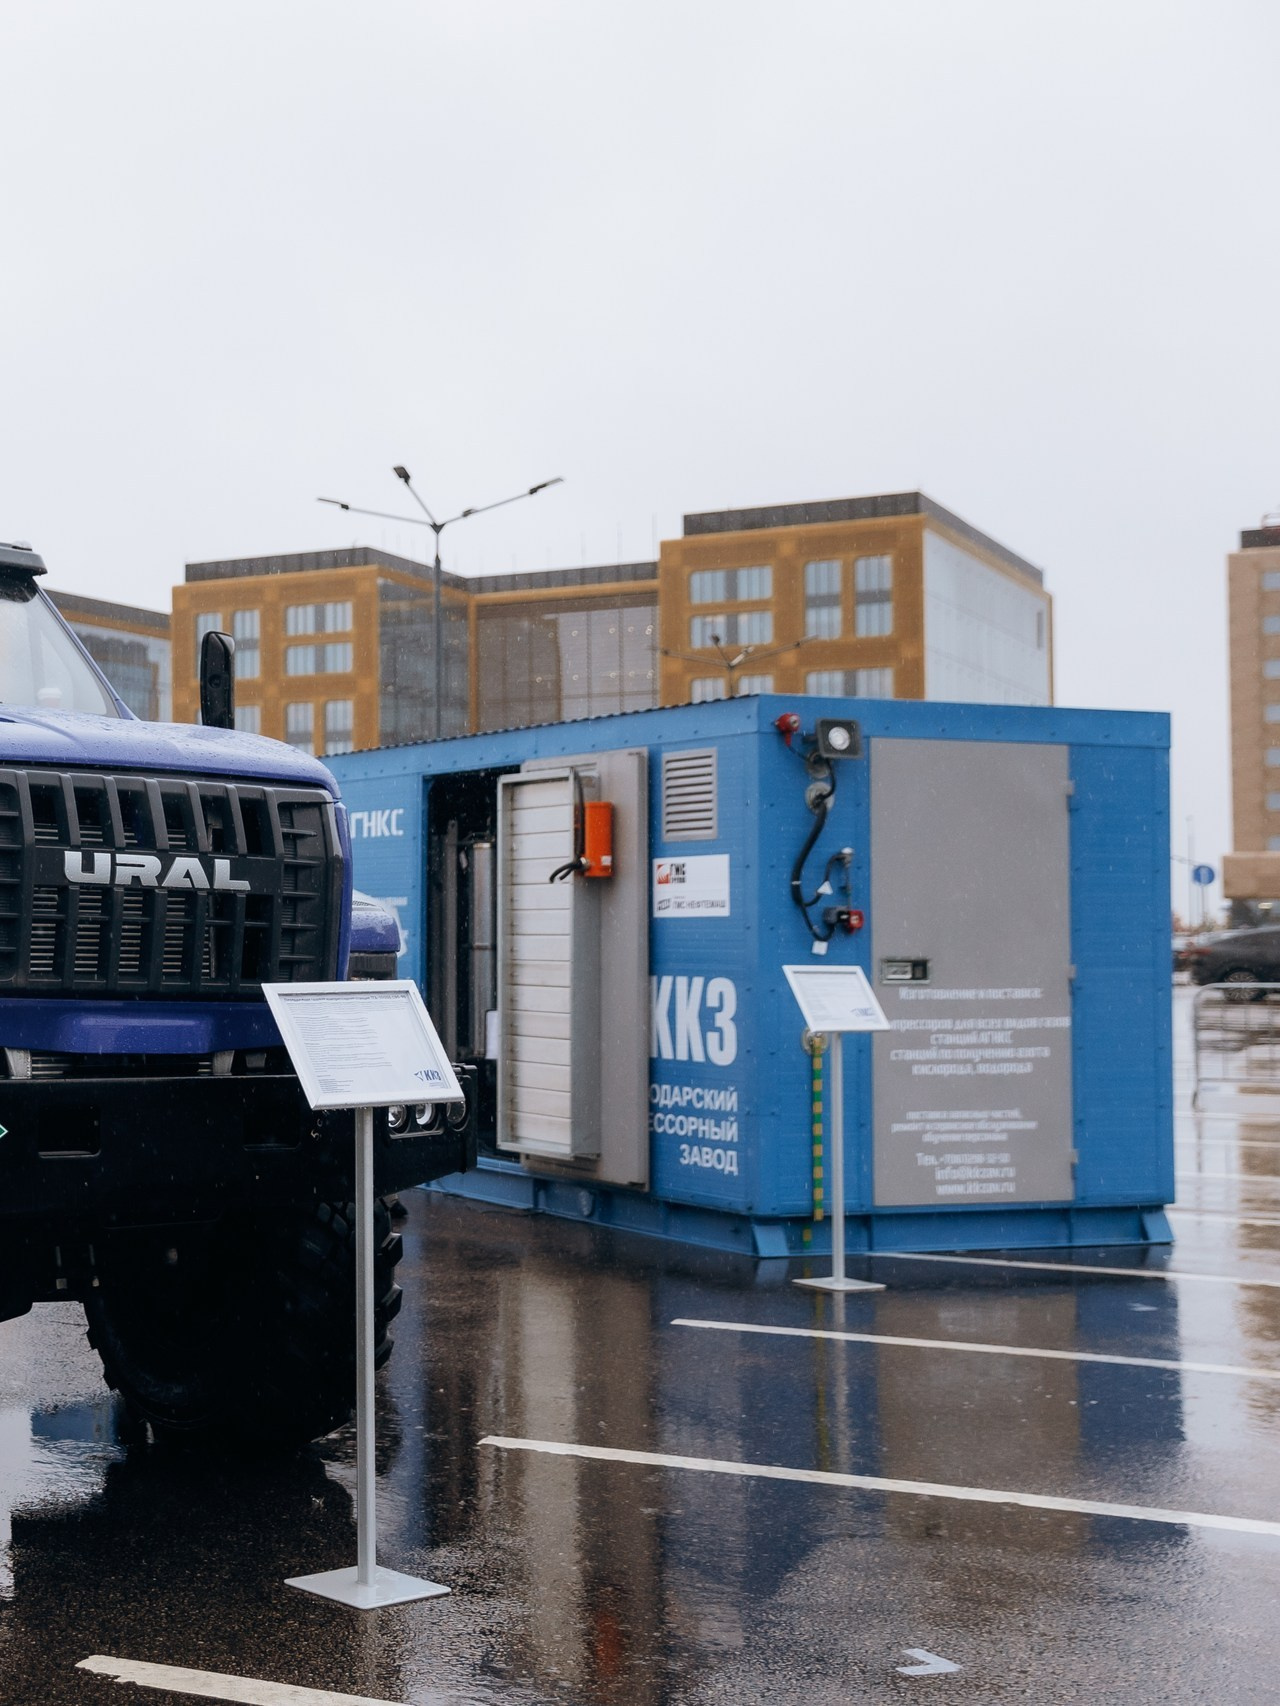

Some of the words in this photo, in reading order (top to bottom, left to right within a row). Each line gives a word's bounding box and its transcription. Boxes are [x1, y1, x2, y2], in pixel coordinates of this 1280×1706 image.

[350, 808, 404, 839] ГНКС
[64, 850, 252, 891] URAL
[650, 974, 738, 1067] ККЗ
[650, 1083, 738, 1113] ОДАРСКИЙ
[679, 1143, 739, 1176] ЗАВОД
